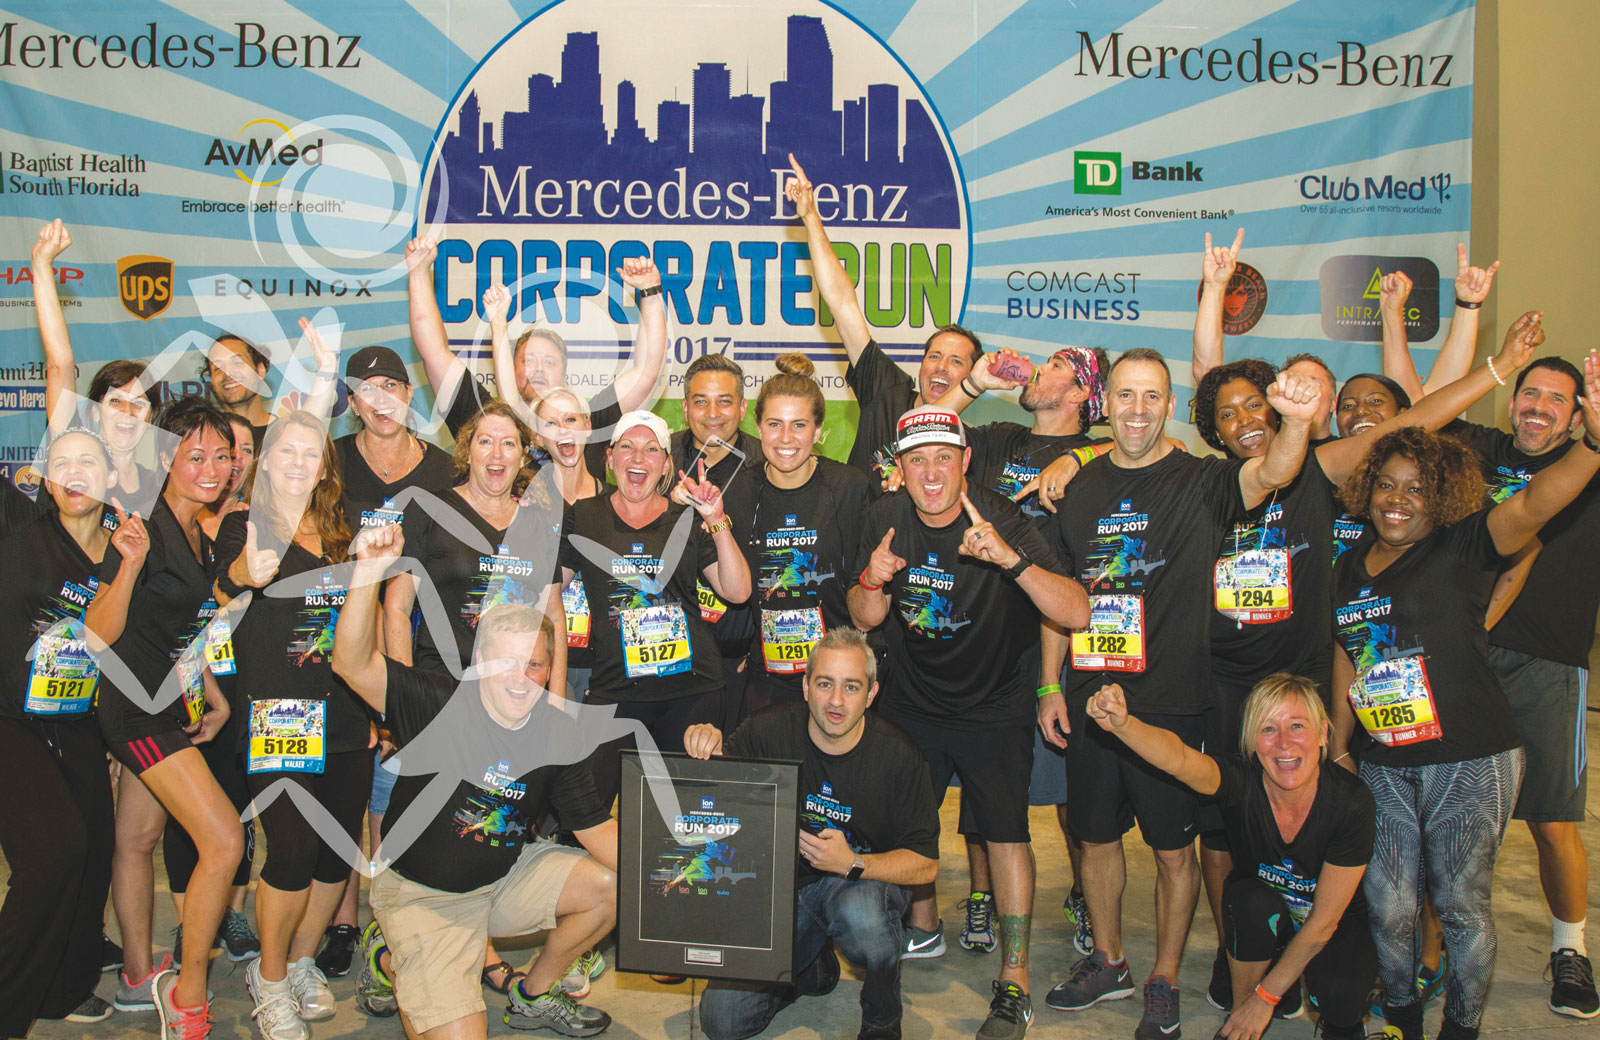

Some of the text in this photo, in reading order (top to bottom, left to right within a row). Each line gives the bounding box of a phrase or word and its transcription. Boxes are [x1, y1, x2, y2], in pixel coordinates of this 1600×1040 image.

[1074, 30, 1454, 88] Mercedes-Benz
[204, 138, 323, 166] AvMed
[9, 152, 146, 177] Baptist Health
[1078, 159, 1118, 186] TD
[1132, 161, 1204, 182] Bank
[9, 175, 140, 197] South Florida
[1300, 175, 1426, 201] Club Med
[182, 200, 246, 213] Embrace
[250, 200, 295, 213] better
[1045, 206, 1099, 217] America's
[1102, 207, 1131, 218] Most
[1134, 208, 1198, 219] Convenient
[1300, 204, 1317, 213] Over
[1378, 204, 1401, 213] resorts
[1403, 204, 1442, 214] worldwide
[214, 279, 372, 299] EQUINOX
[1007, 270, 1141, 294] COMCAST
[121, 275, 169, 311] ups
[1007, 297, 1140, 321] BUSINESS
[666, 336, 732, 365] 017
[360, 516, 386, 527] RUN
[1097, 513, 1149, 526] CORPORATE
[1097, 521, 1149, 534] RUN 2017
[766, 529, 818, 539] CORPORATE
[766, 536, 818, 547] RUN 2017
[1339, 529, 1363, 540] 2017
[479, 556, 533, 568] CORPORATE
[479, 562, 533, 577] RUN 2017
[611, 558, 665, 566] CORPORATE
[612, 565, 665, 574] RUN 2017
[908, 567, 955, 582] CORPORATE
[908, 574, 954, 591] RUN 2017
[60, 586, 87, 606] RUN
[64, 580, 96, 600] CORPO
[1232, 590, 1274, 607] 1294
[1335, 596, 1392, 616] CORPORATE
[1337, 604, 1392, 626] RUN 2017
[639, 643, 677, 663] 5127
[776, 644, 810, 660] 1291
[1087, 636, 1127, 654] 1282
[46, 679, 84, 698] 5121
[1369, 704, 1416, 728] 1285
[1394, 730, 1417, 742] RUNNER
[264, 738, 308, 755] 5128
[284, 760, 305, 768] WALKER
[499, 786, 526, 801] 2017
[674, 815, 740, 825] CORPORATE
[826, 808, 852, 823] 2017
[674, 822, 739, 835] RUN 2017
[1257, 868, 1286, 886] RUN
[1287, 879, 1317, 893] 2017
